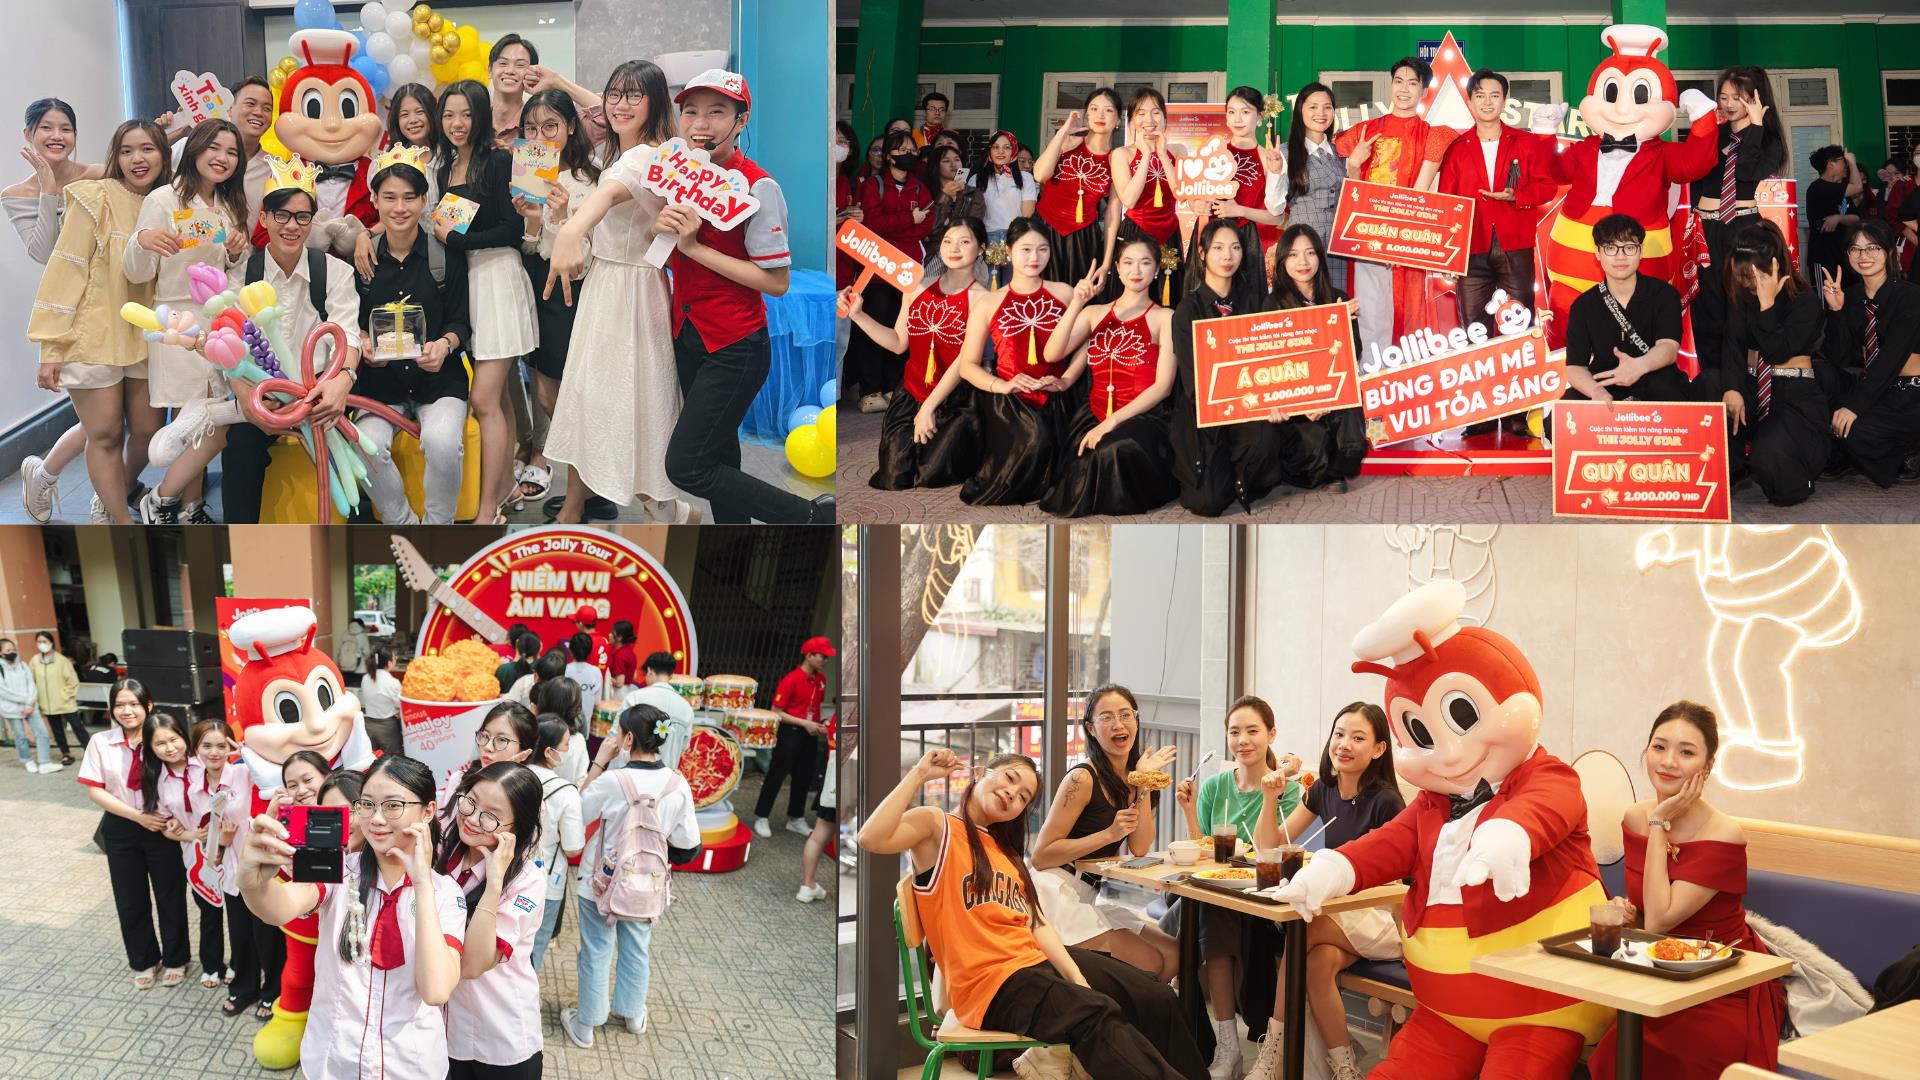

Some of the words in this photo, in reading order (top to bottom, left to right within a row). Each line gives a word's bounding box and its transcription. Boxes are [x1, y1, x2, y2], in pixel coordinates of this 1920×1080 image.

[178, 84, 200, 112] xinh
[668, 151, 727, 189] Happy
[1177, 158, 1183, 181] I
[647, 164, 751, 223] Birthday
[1175, 181, 1234, 197] Jollibee
[1389, 193, 1418, 202] Jollibee
[1356, 222, 1398, 239] QUÁN
[1400, 229, 1442, 245] QUÂN
[841, 229, 897, 275] Jollibee
[1251, 322, 1284, 332] Jollibee
[1363, 322, 1488, 373] Jollibee
[1236, 366, 1253, 389] Á
[1254, 361, 1310, 386] QUÂN
[1364, 374, 1434, 410] BỪNG
[1440, 356, 1496, 390] ĐAM
[1502, 341, 1536, 373] MÊ
[1263, 385, 1315, 403] 3.000.000
[1389, 404, 1431, 433] VUI
[1434, 389, 1488, 421] TỎA
[1492, 371, 1561, 406] SÁNG
[1614, 412, 1651, 422] Jollibee
[1596, 435, 1618, 444] THE
[1619, 435, 1653, 446] JOLLY
[1653, 436, 1682, 446] STAR
[1582, 460, 1628, 483] QUÝ
[1630, 460, 1690, 483] QUÂN
[1623, 491, 1680, 502] 2.000.000
[512, 544, 540, 559] The
[543, 538, 578, 553] Jolly
[581, 540, 613, 560] Tour
[511, 564, 568, 592] NIỀM
[571, 570, 611, 593] VUI
[506, 592, 544, 617] ÂM
[420, 740, 436, 752] 40
